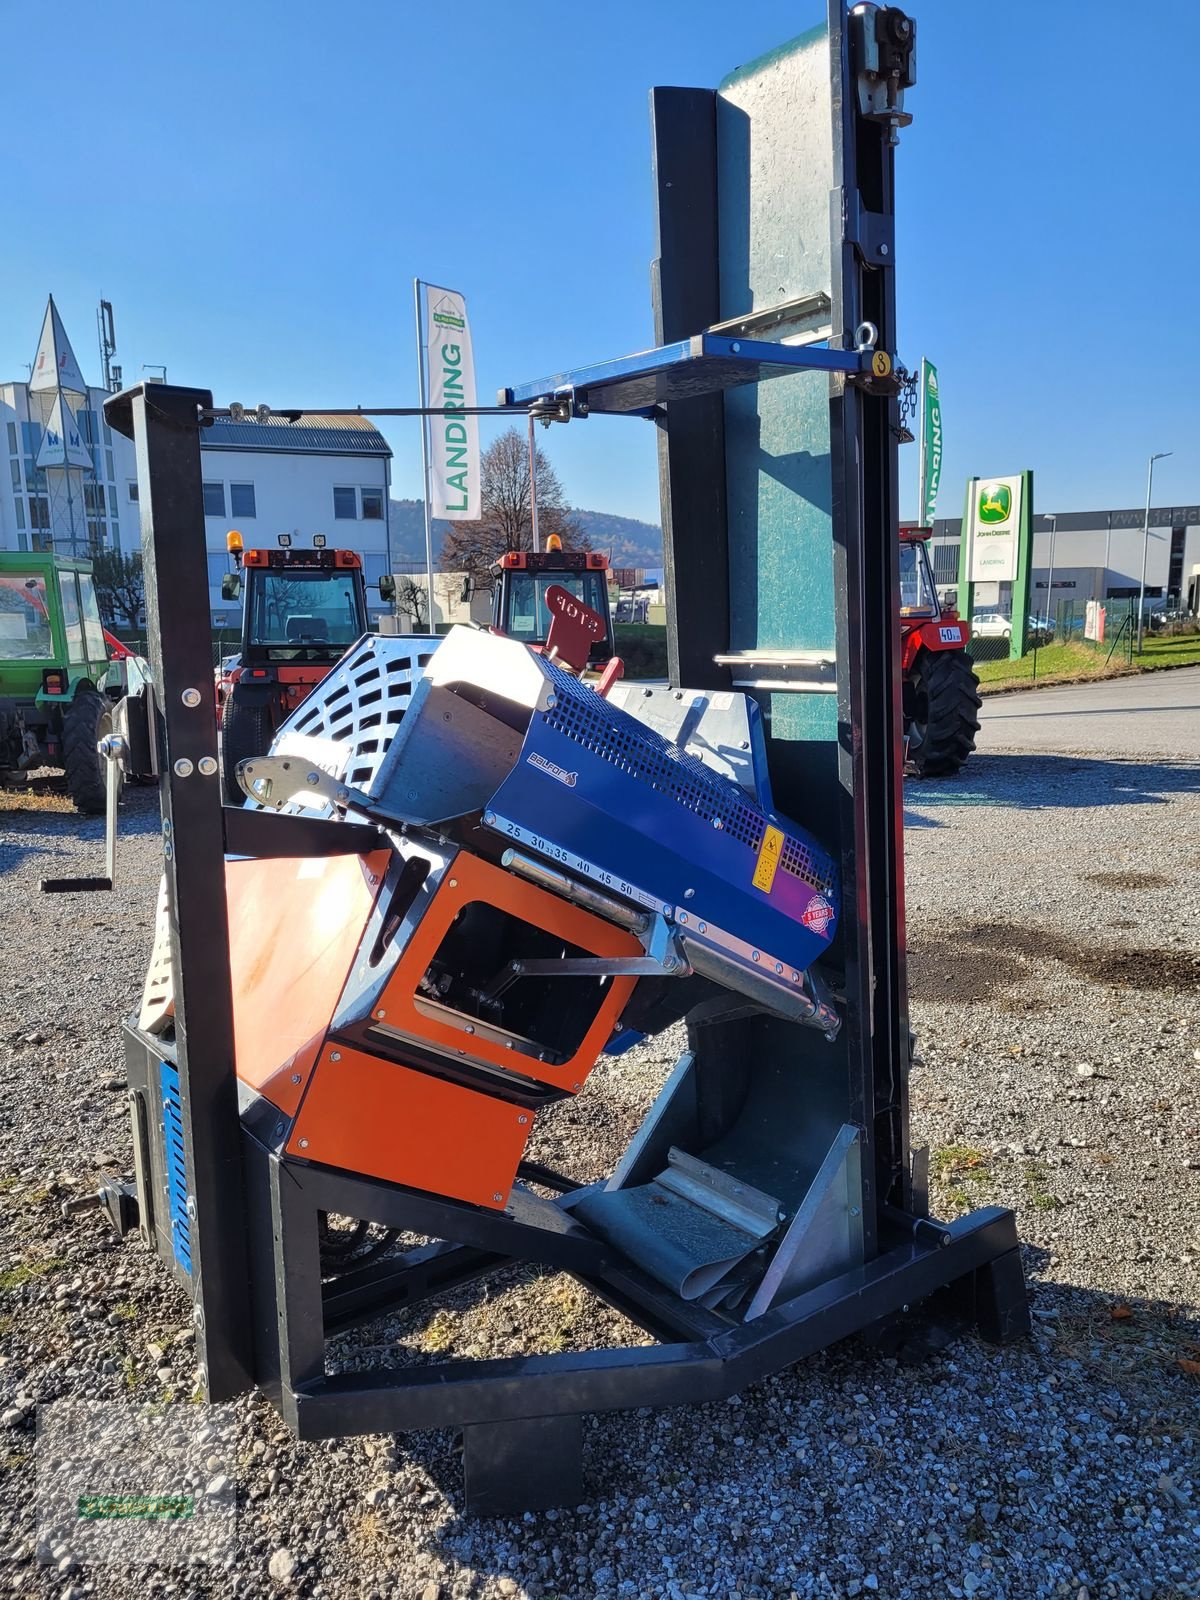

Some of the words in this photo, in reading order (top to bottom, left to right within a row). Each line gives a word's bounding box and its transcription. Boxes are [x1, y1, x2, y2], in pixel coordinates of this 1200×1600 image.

[441, 344, 468, 511] LANDRING
[977, 530, 991, 538] JOHN
[941, 628, 953, 641] 40
[507, 823, 521, 837] 25
[531, 836, 545, 849] 30
[555, 848, 568, 862] 35
[577, 860, 590, 873] 40
[599, 872, 612, 884] 45
[620, 883, 633, 895] 50
